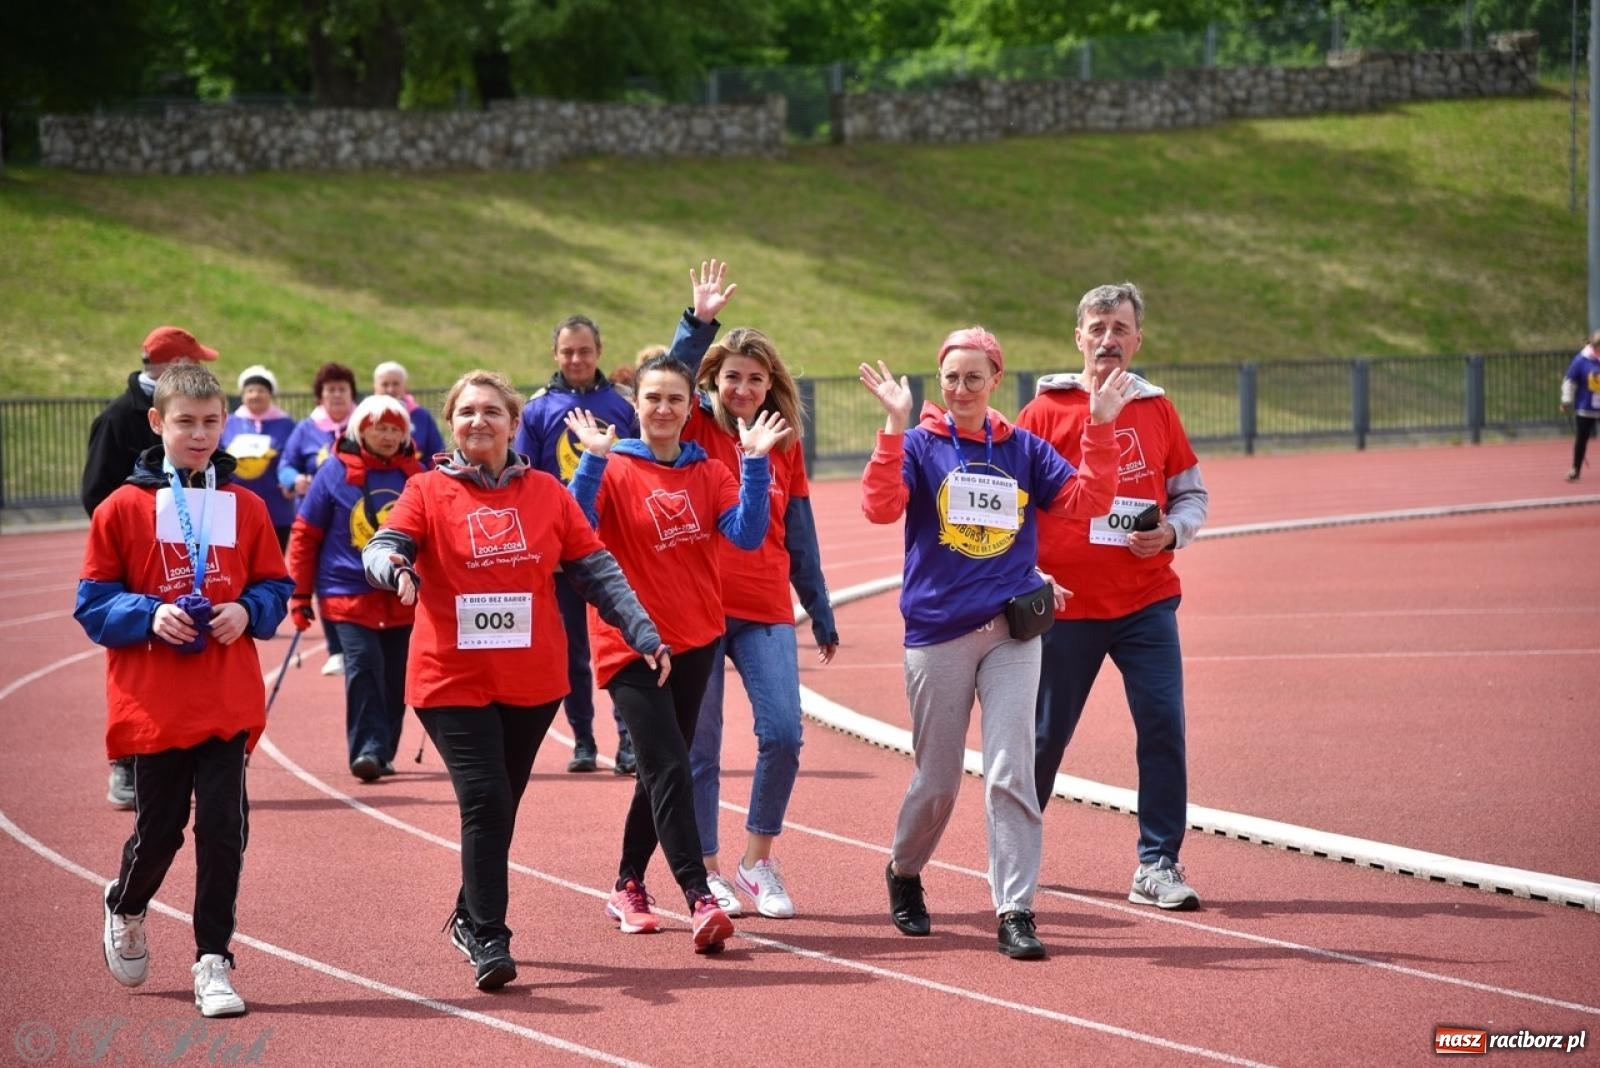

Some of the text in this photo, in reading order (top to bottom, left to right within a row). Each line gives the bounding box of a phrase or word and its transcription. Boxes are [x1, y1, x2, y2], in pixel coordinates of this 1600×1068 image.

[968, 491, 1002, 511] 156
[1108, 513, 1139, 530] 00
[478, 541, 522, 555] 2004-2024
[465, 560, 480, 569] Tak
[474, 612, 515, 630] 003
